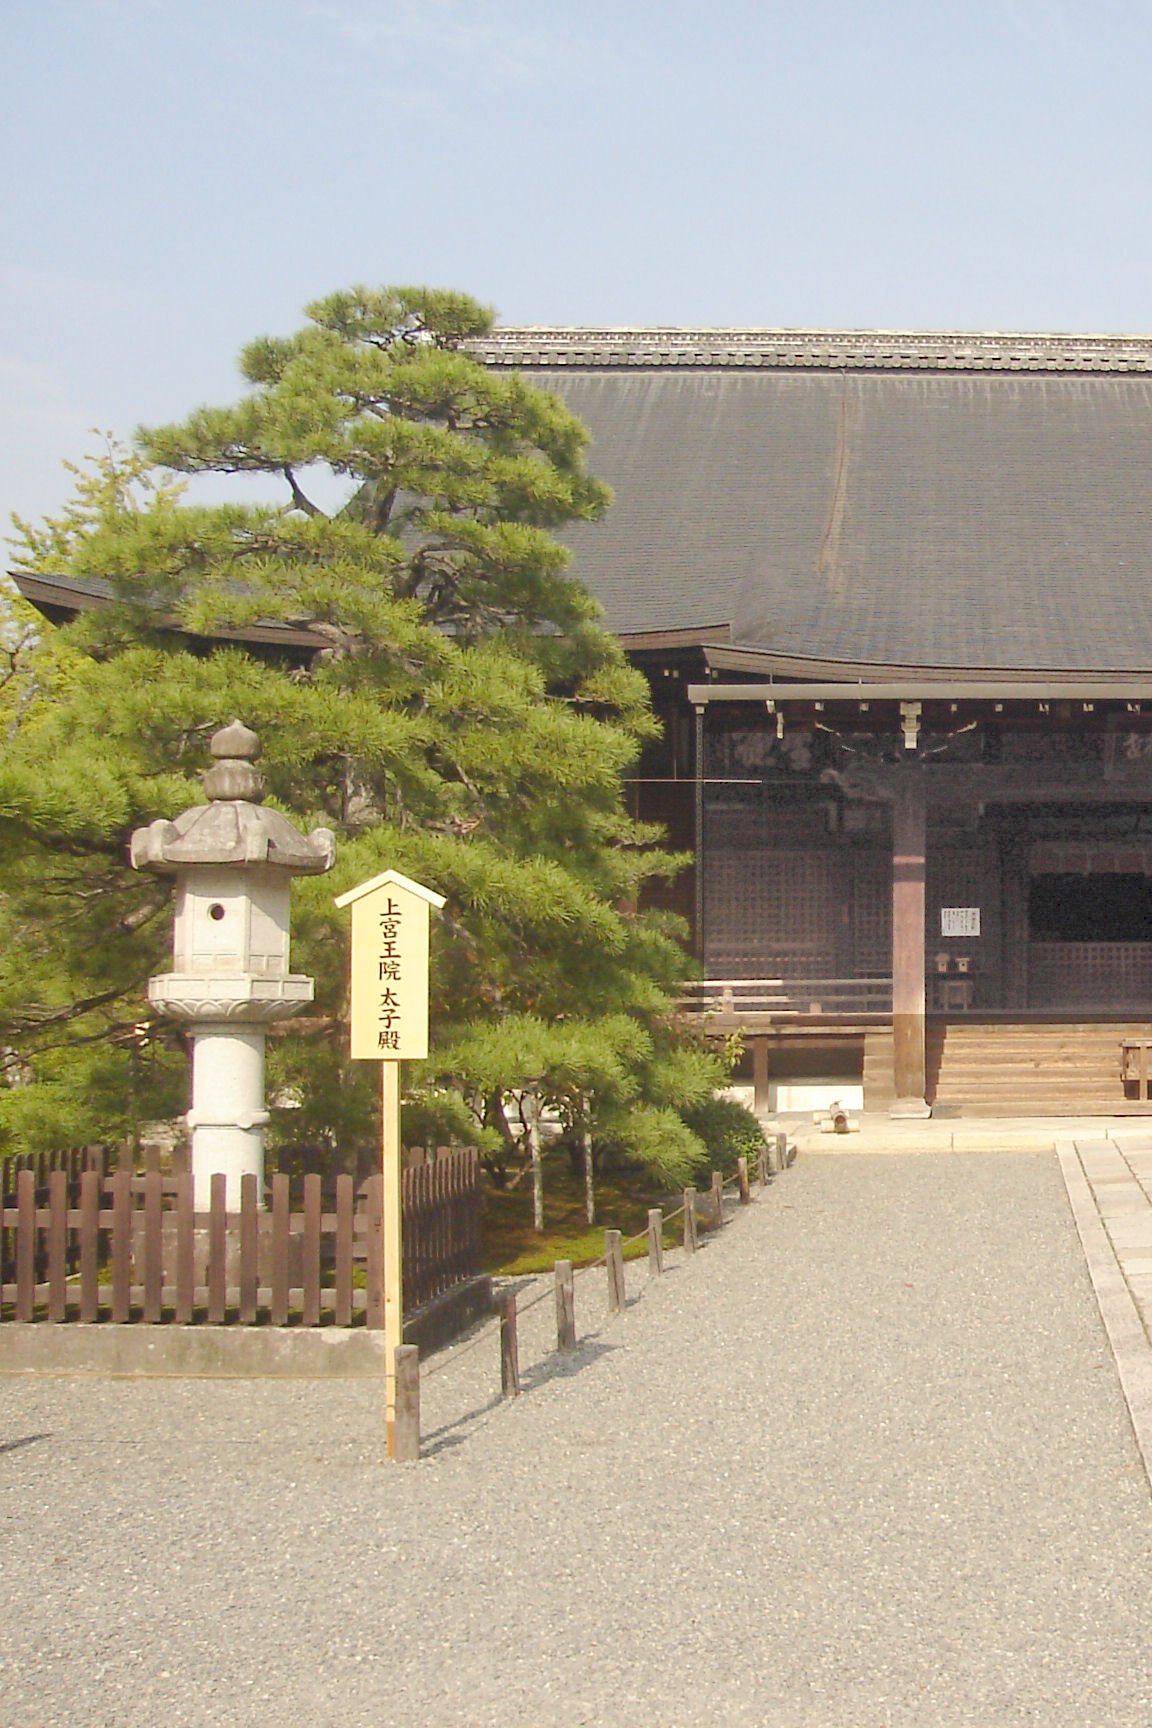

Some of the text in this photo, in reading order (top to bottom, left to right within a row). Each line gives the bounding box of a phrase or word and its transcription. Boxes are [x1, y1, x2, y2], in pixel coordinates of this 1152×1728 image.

[378, 897, 402, 1050] 上宮王院 太子殿
